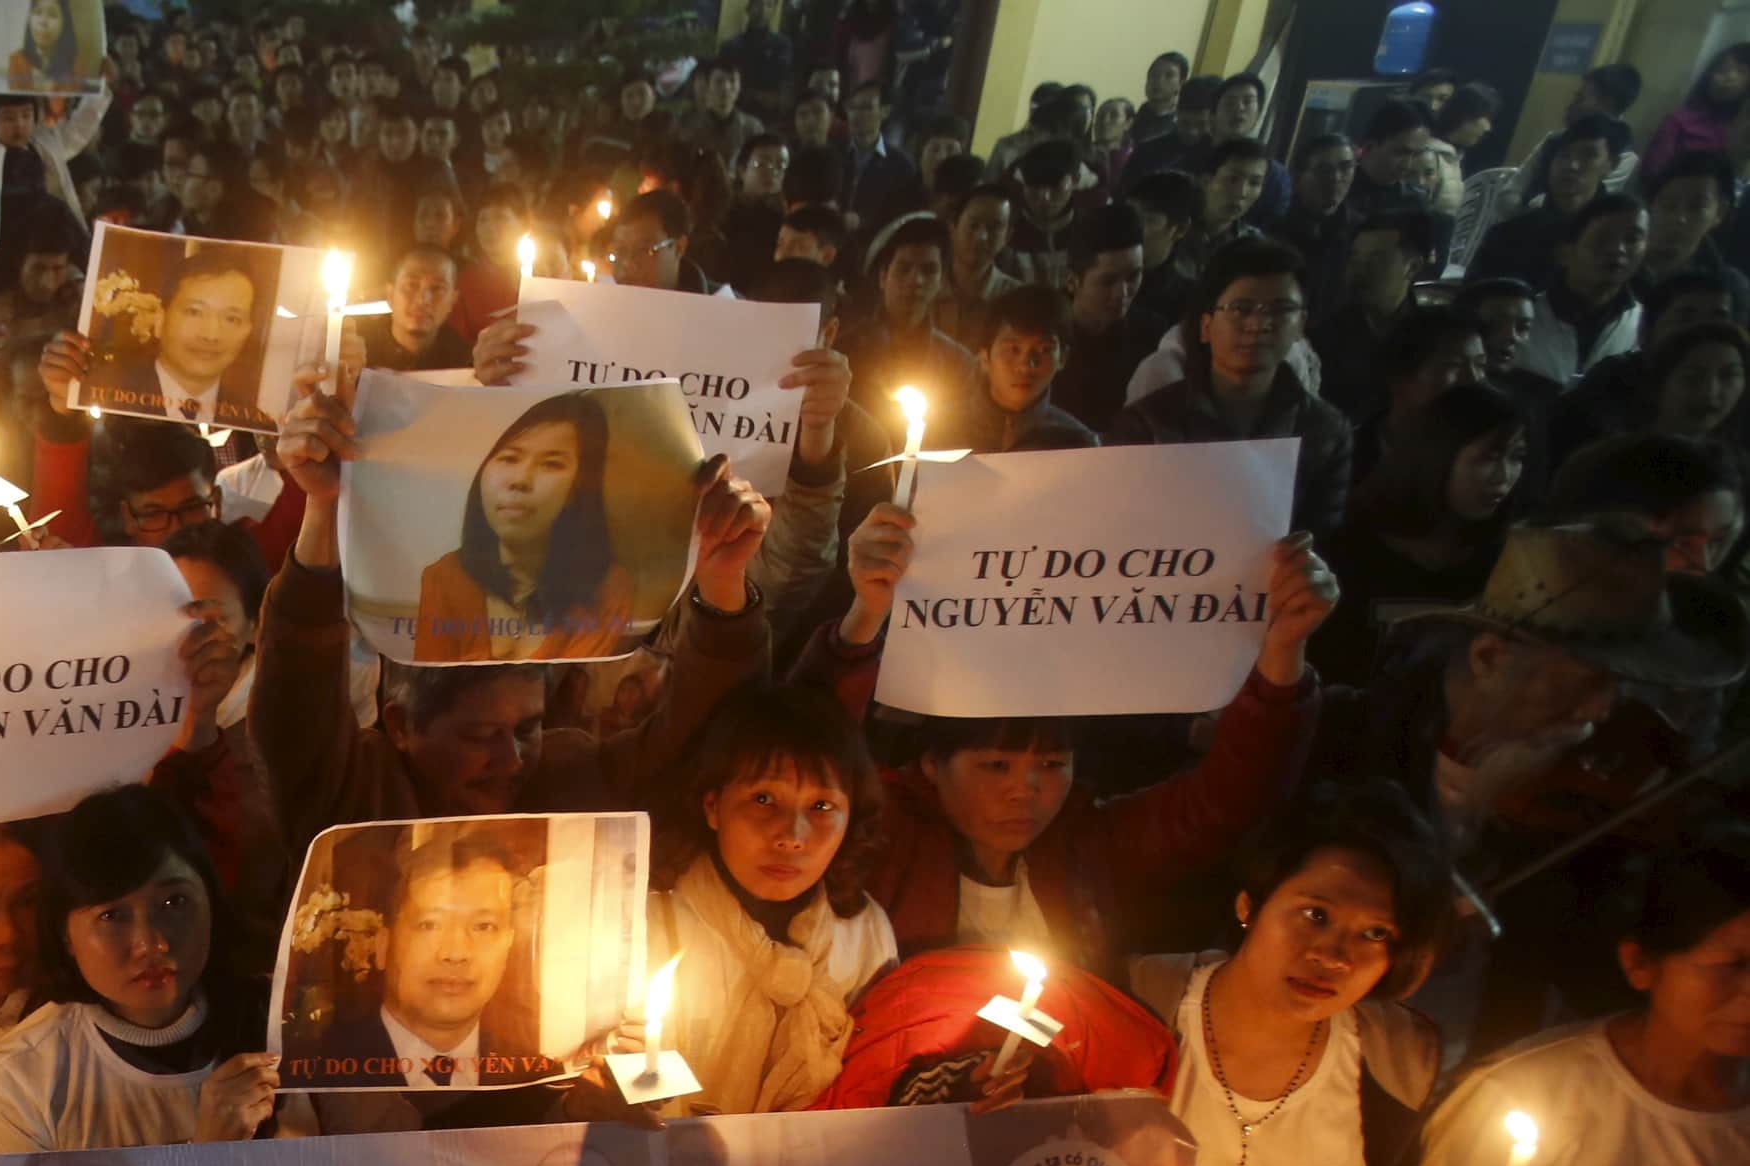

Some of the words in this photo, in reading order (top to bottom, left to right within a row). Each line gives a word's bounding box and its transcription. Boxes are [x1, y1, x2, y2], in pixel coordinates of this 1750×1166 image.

[114, 389, 137, 405] DO
[680, 372, 750, 400] CHO
[733, 412, 791, 444] ĐÀI
[972, 545, 1038, 587] TỰ
[1042, 549, 1106, 579] DO
[1118, 549, 1216, 578] CHO
[901, 588, 1080, 629] NGUYỄN
[1090, 587, 1181, 625] VĂN
[1187, 584, 1271, 624] ĐÀI
[45, 655, 131, 690] CHO
[23, 698, 106, 737] VĂN
[113, 688, 185, 730] ĐÀI
[290, 1056, 322, 1079] TỰ
[324, 1057, 357, 1077] DO
[363, 1056, 413, 1075] CHO
[1065, 1151, 1083, 1166] có
